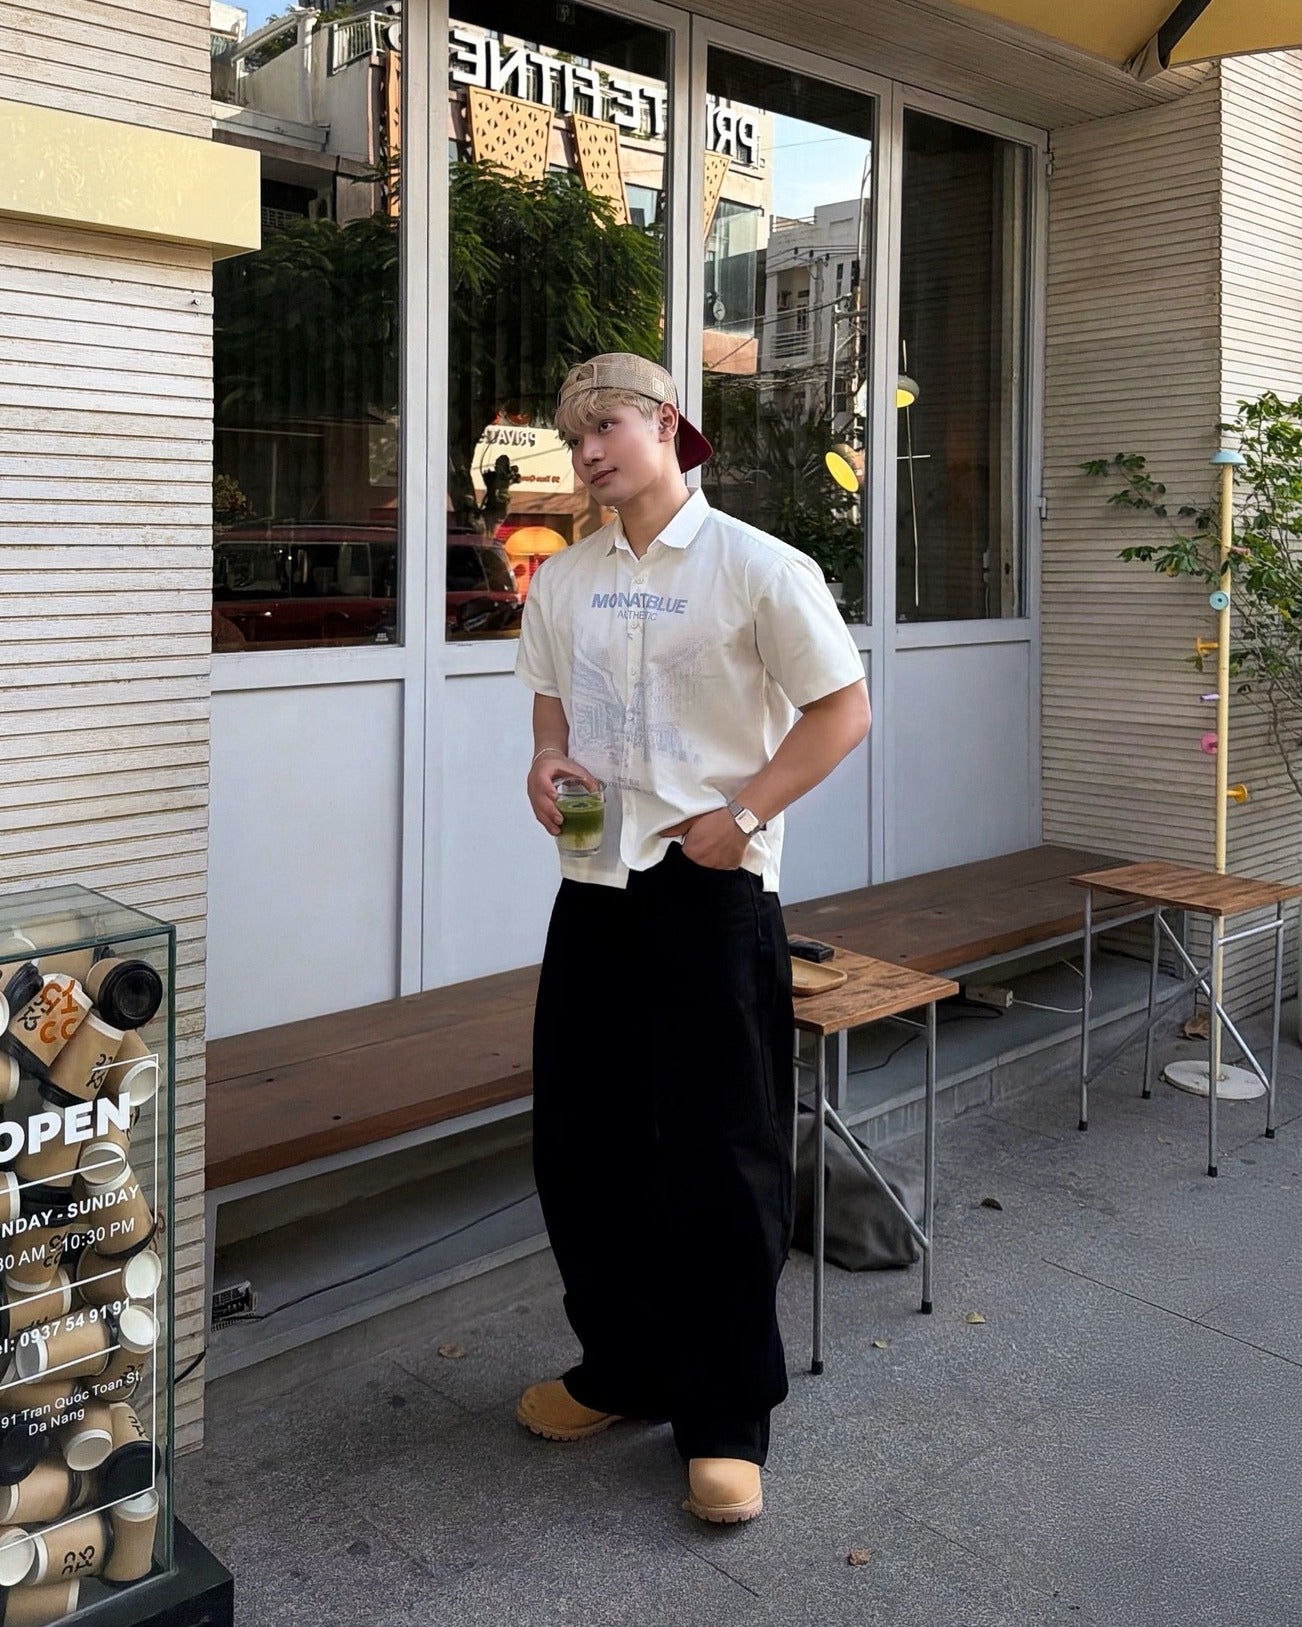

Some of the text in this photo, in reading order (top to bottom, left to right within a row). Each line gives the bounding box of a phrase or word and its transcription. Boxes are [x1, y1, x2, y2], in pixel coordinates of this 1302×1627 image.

[0, 1092, 131, 1163] OPEN
[67, 1184, 140, 1219] SUNDAY
[18, 1244, 45, 1266] AM
[62, 1226, 106, 1252] 10:30
[110, 1217, 135, 1238] PM
[20, 1320, 61, 1347] 0937
[65, 1312, 85, 1332] 54
[89, 1304, 108, 1324] 91
[112, 1297, 130, 1316] 91
[1, 1370, 143, 1429] 91 Tran Quoc Toan St,
[28, 1408, 85, 1436] Da Nang
